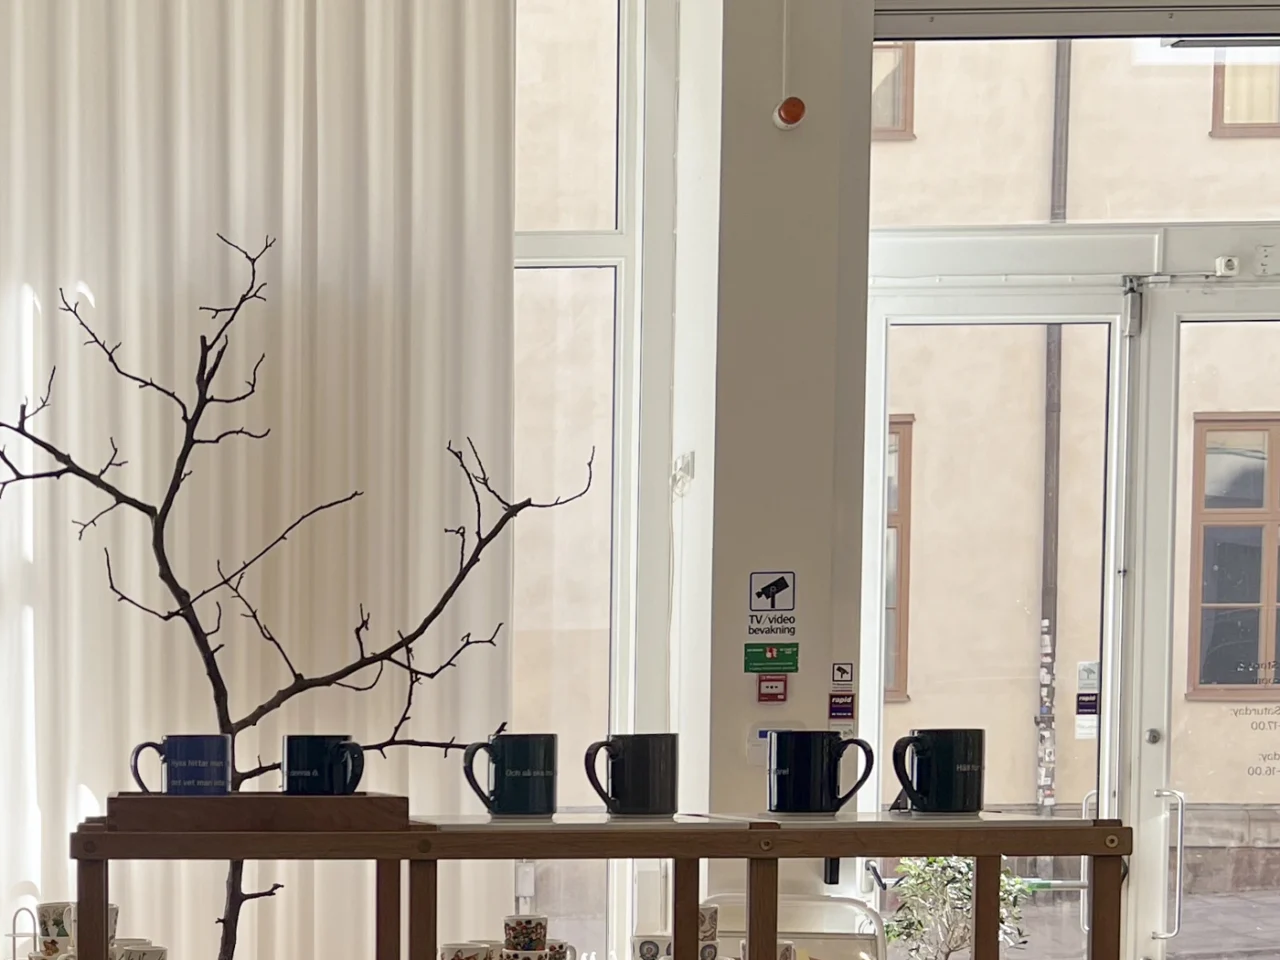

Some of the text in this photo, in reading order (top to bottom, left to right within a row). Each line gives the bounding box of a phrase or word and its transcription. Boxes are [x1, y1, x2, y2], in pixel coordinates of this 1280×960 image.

[748, 614, 796, 625] TV/video
[748, 625, 796, 636] bevakning
[832, 696, 853, 705] rapid
